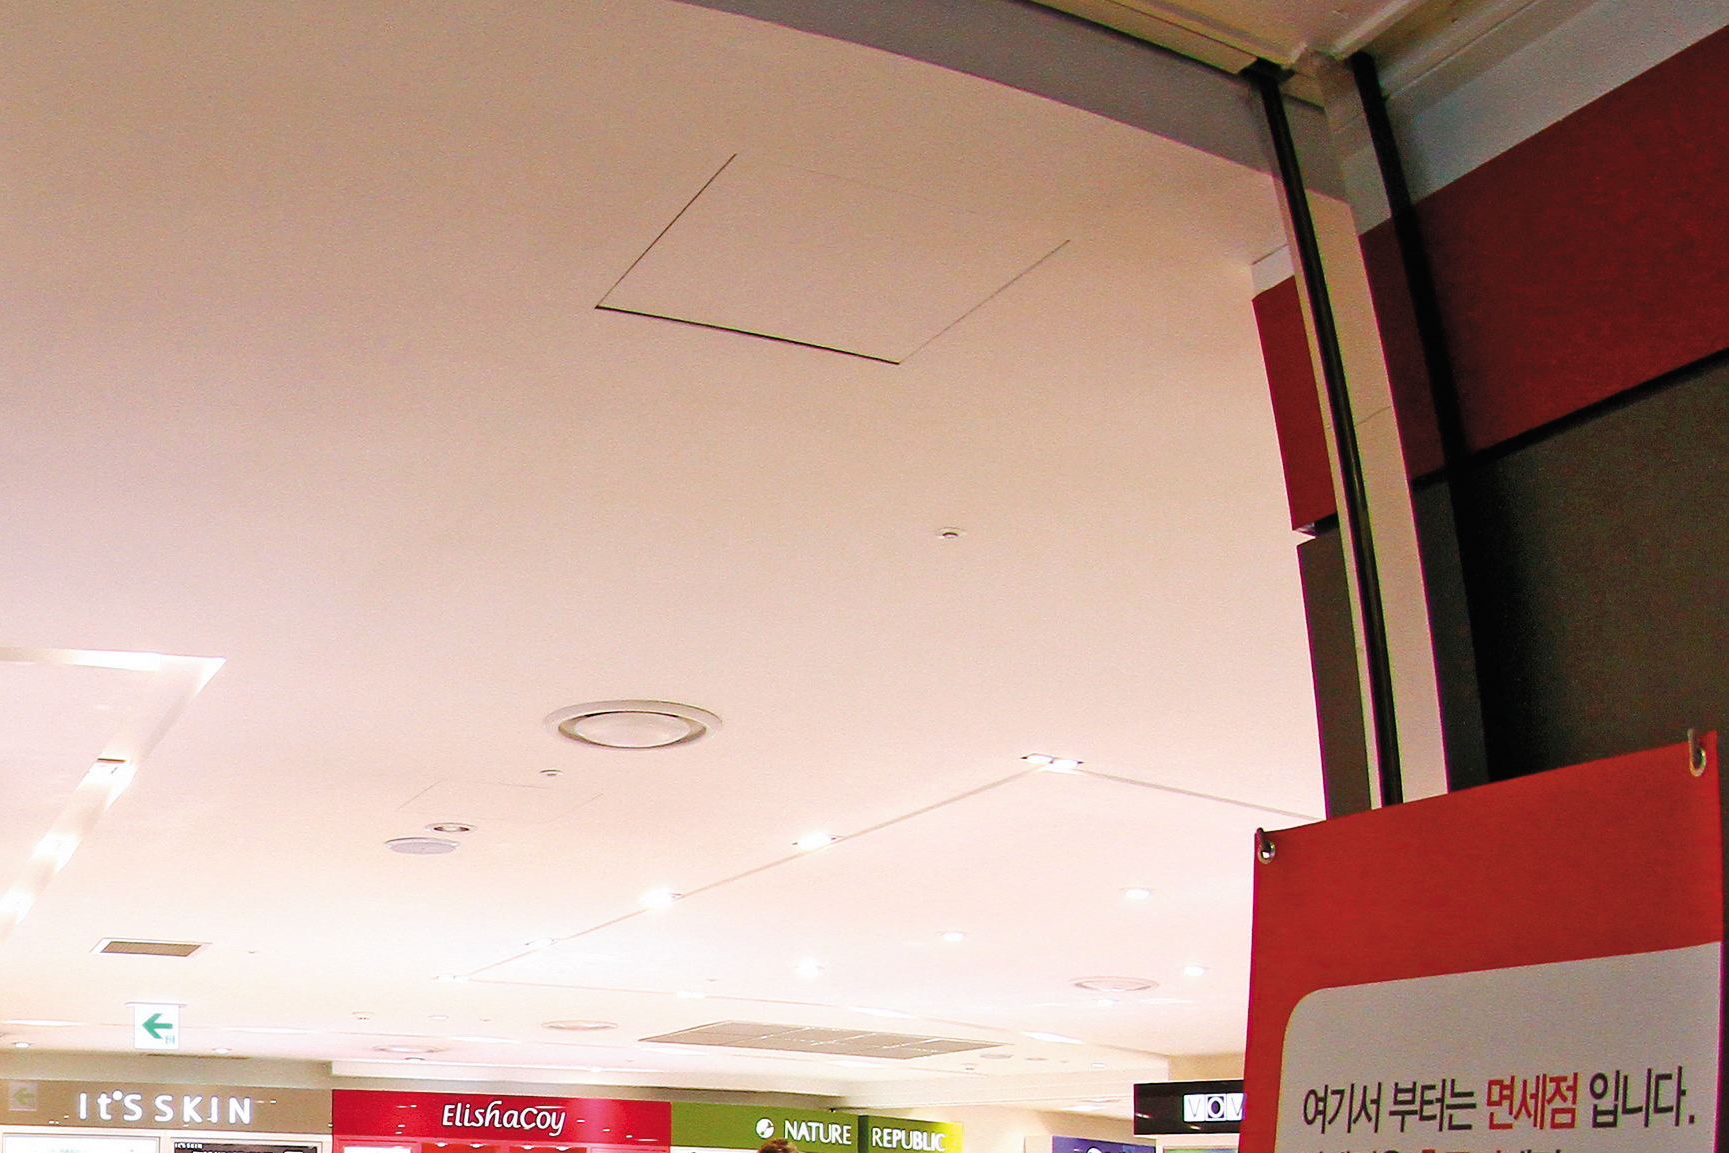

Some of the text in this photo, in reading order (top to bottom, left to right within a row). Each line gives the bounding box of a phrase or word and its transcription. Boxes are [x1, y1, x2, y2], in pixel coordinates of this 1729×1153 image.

[154, 1094, 252, 1125] SKIN
[1302, 1065, 1697, 1134] 여기서 부터는 면세점 입니다.
[442, 1100, 567, 1136] ElishaCoy
[784, 1119, 852, 1145] NATURE
[872, 1127, 946, 1153] REPUBLIC
